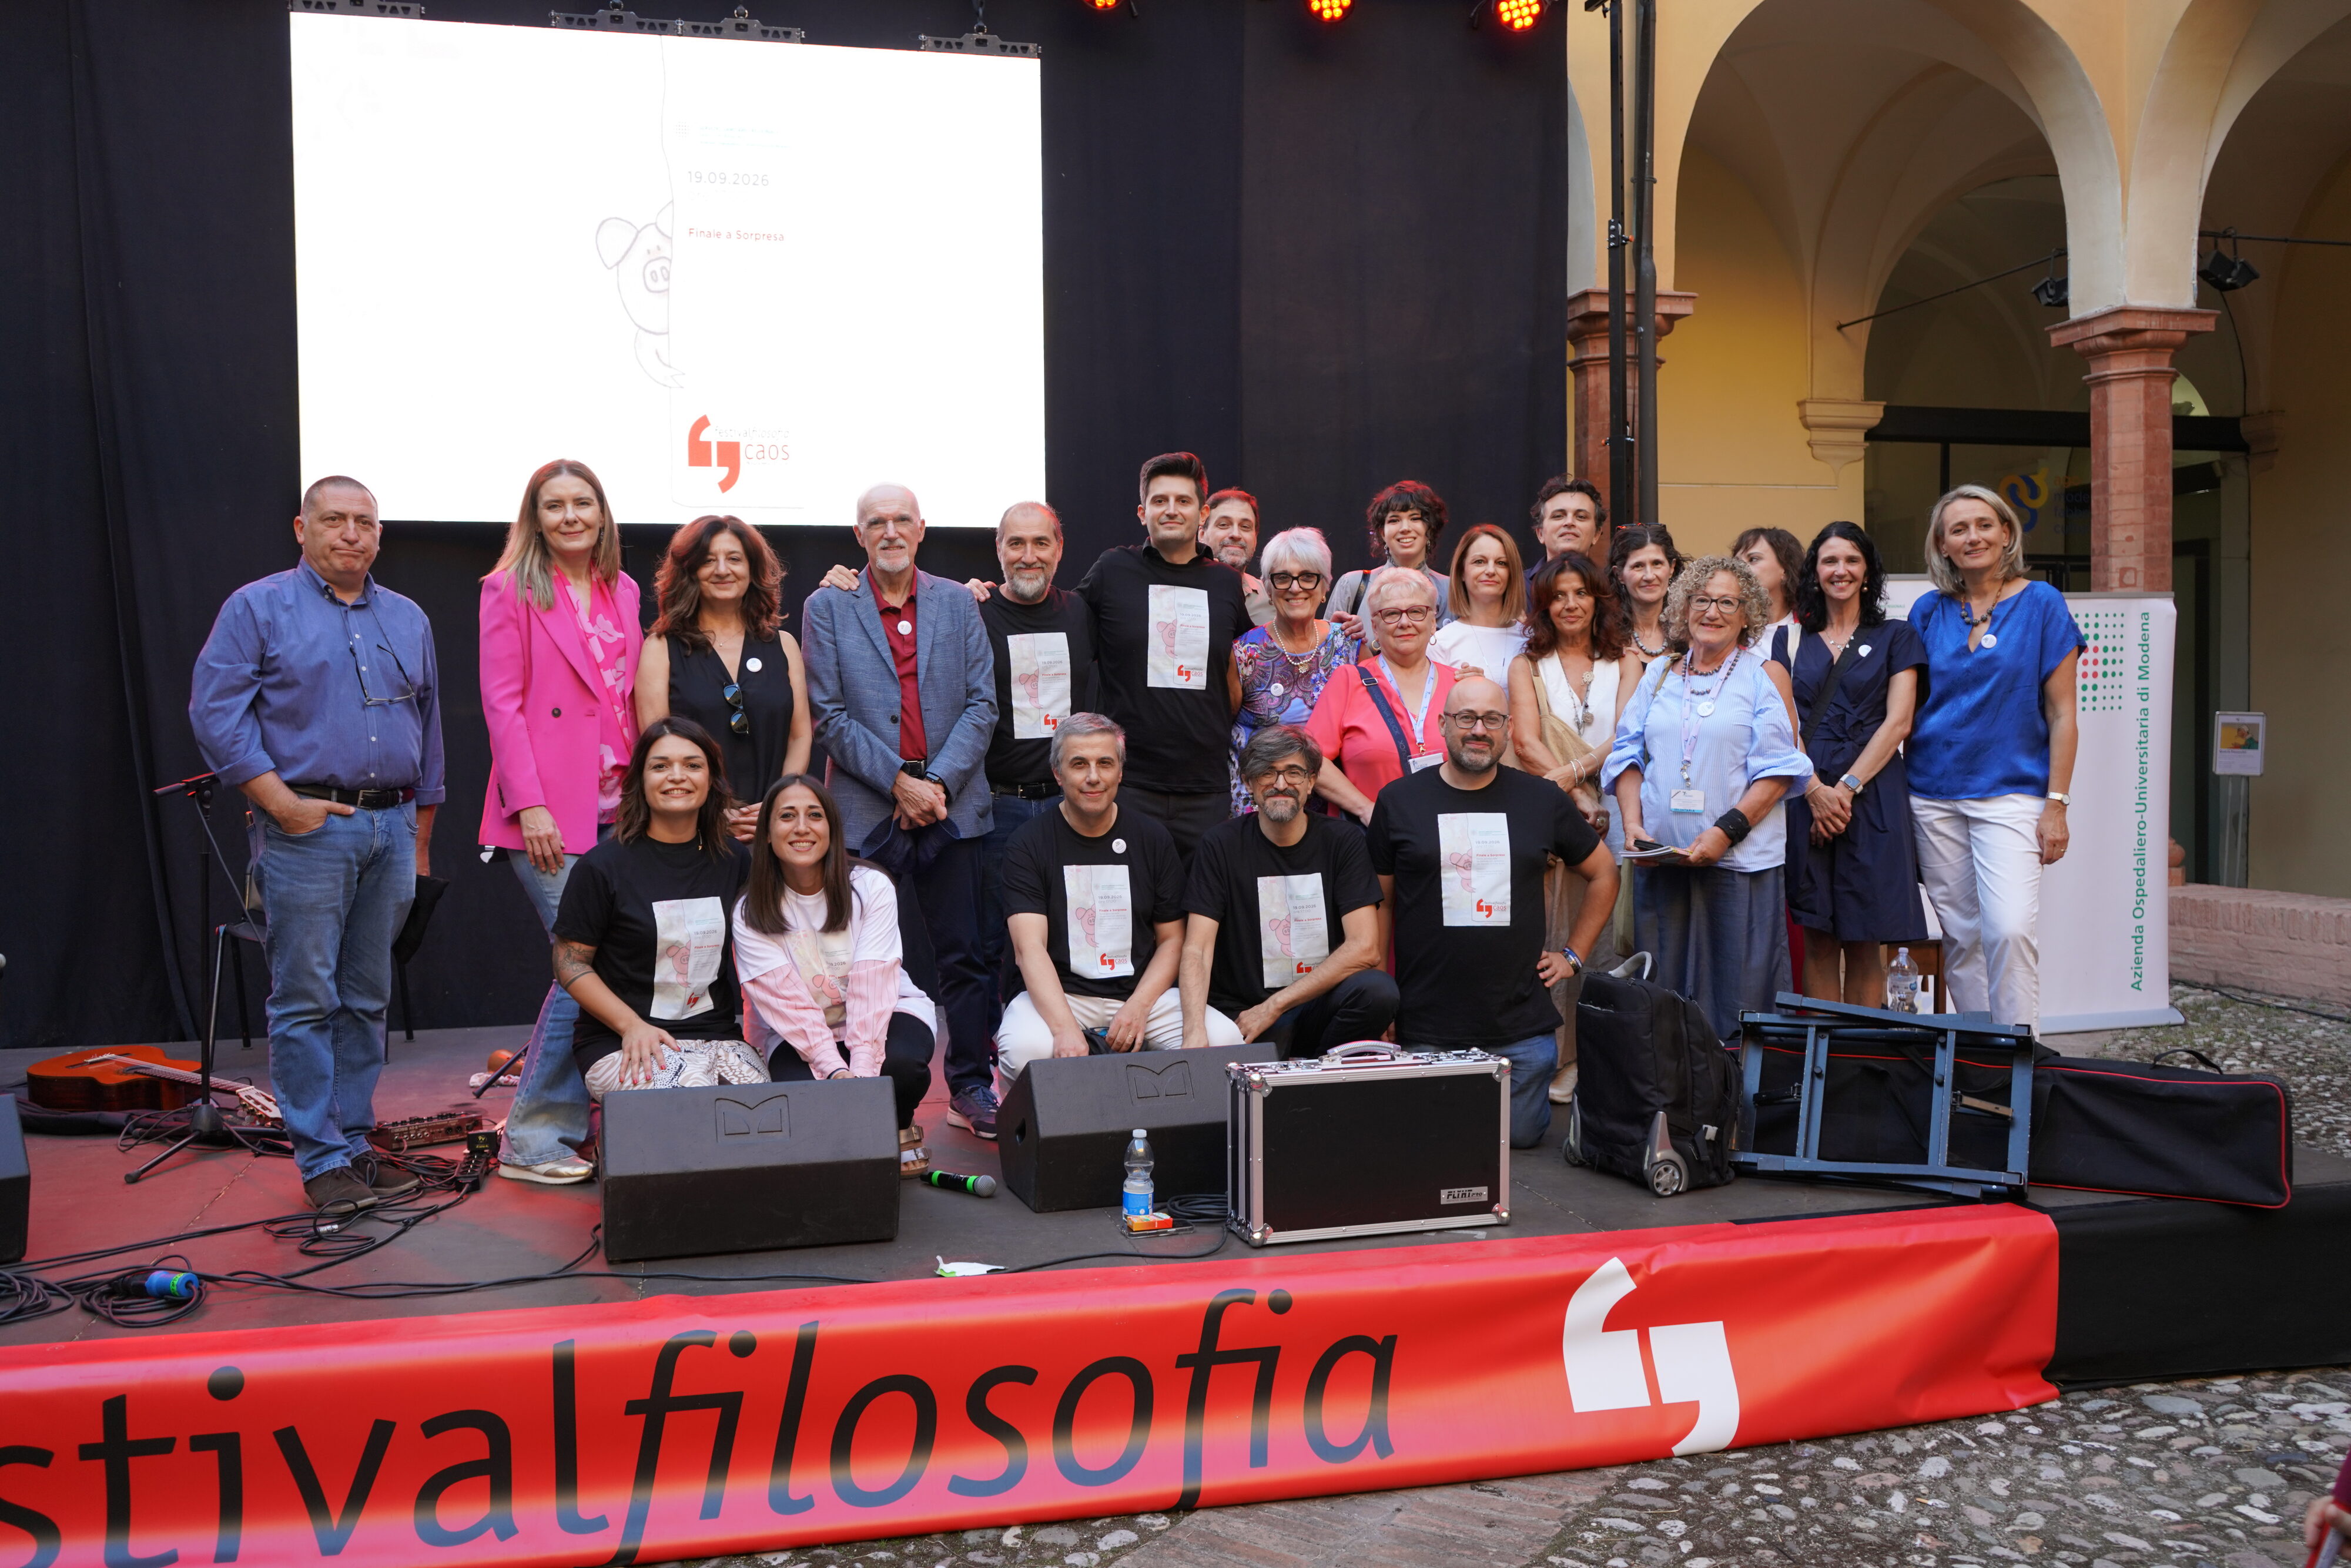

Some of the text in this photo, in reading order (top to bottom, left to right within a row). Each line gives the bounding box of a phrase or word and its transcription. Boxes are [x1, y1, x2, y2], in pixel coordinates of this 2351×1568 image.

[688, 171, 769, 186] 19.09.2026
[688, 228, 785, 242] Finale a Sorpresa
[745, 444, 789, 461] caos
[2131, 612, 2149, 991] Azienda Ospedaliero-Universitaria di Modena
